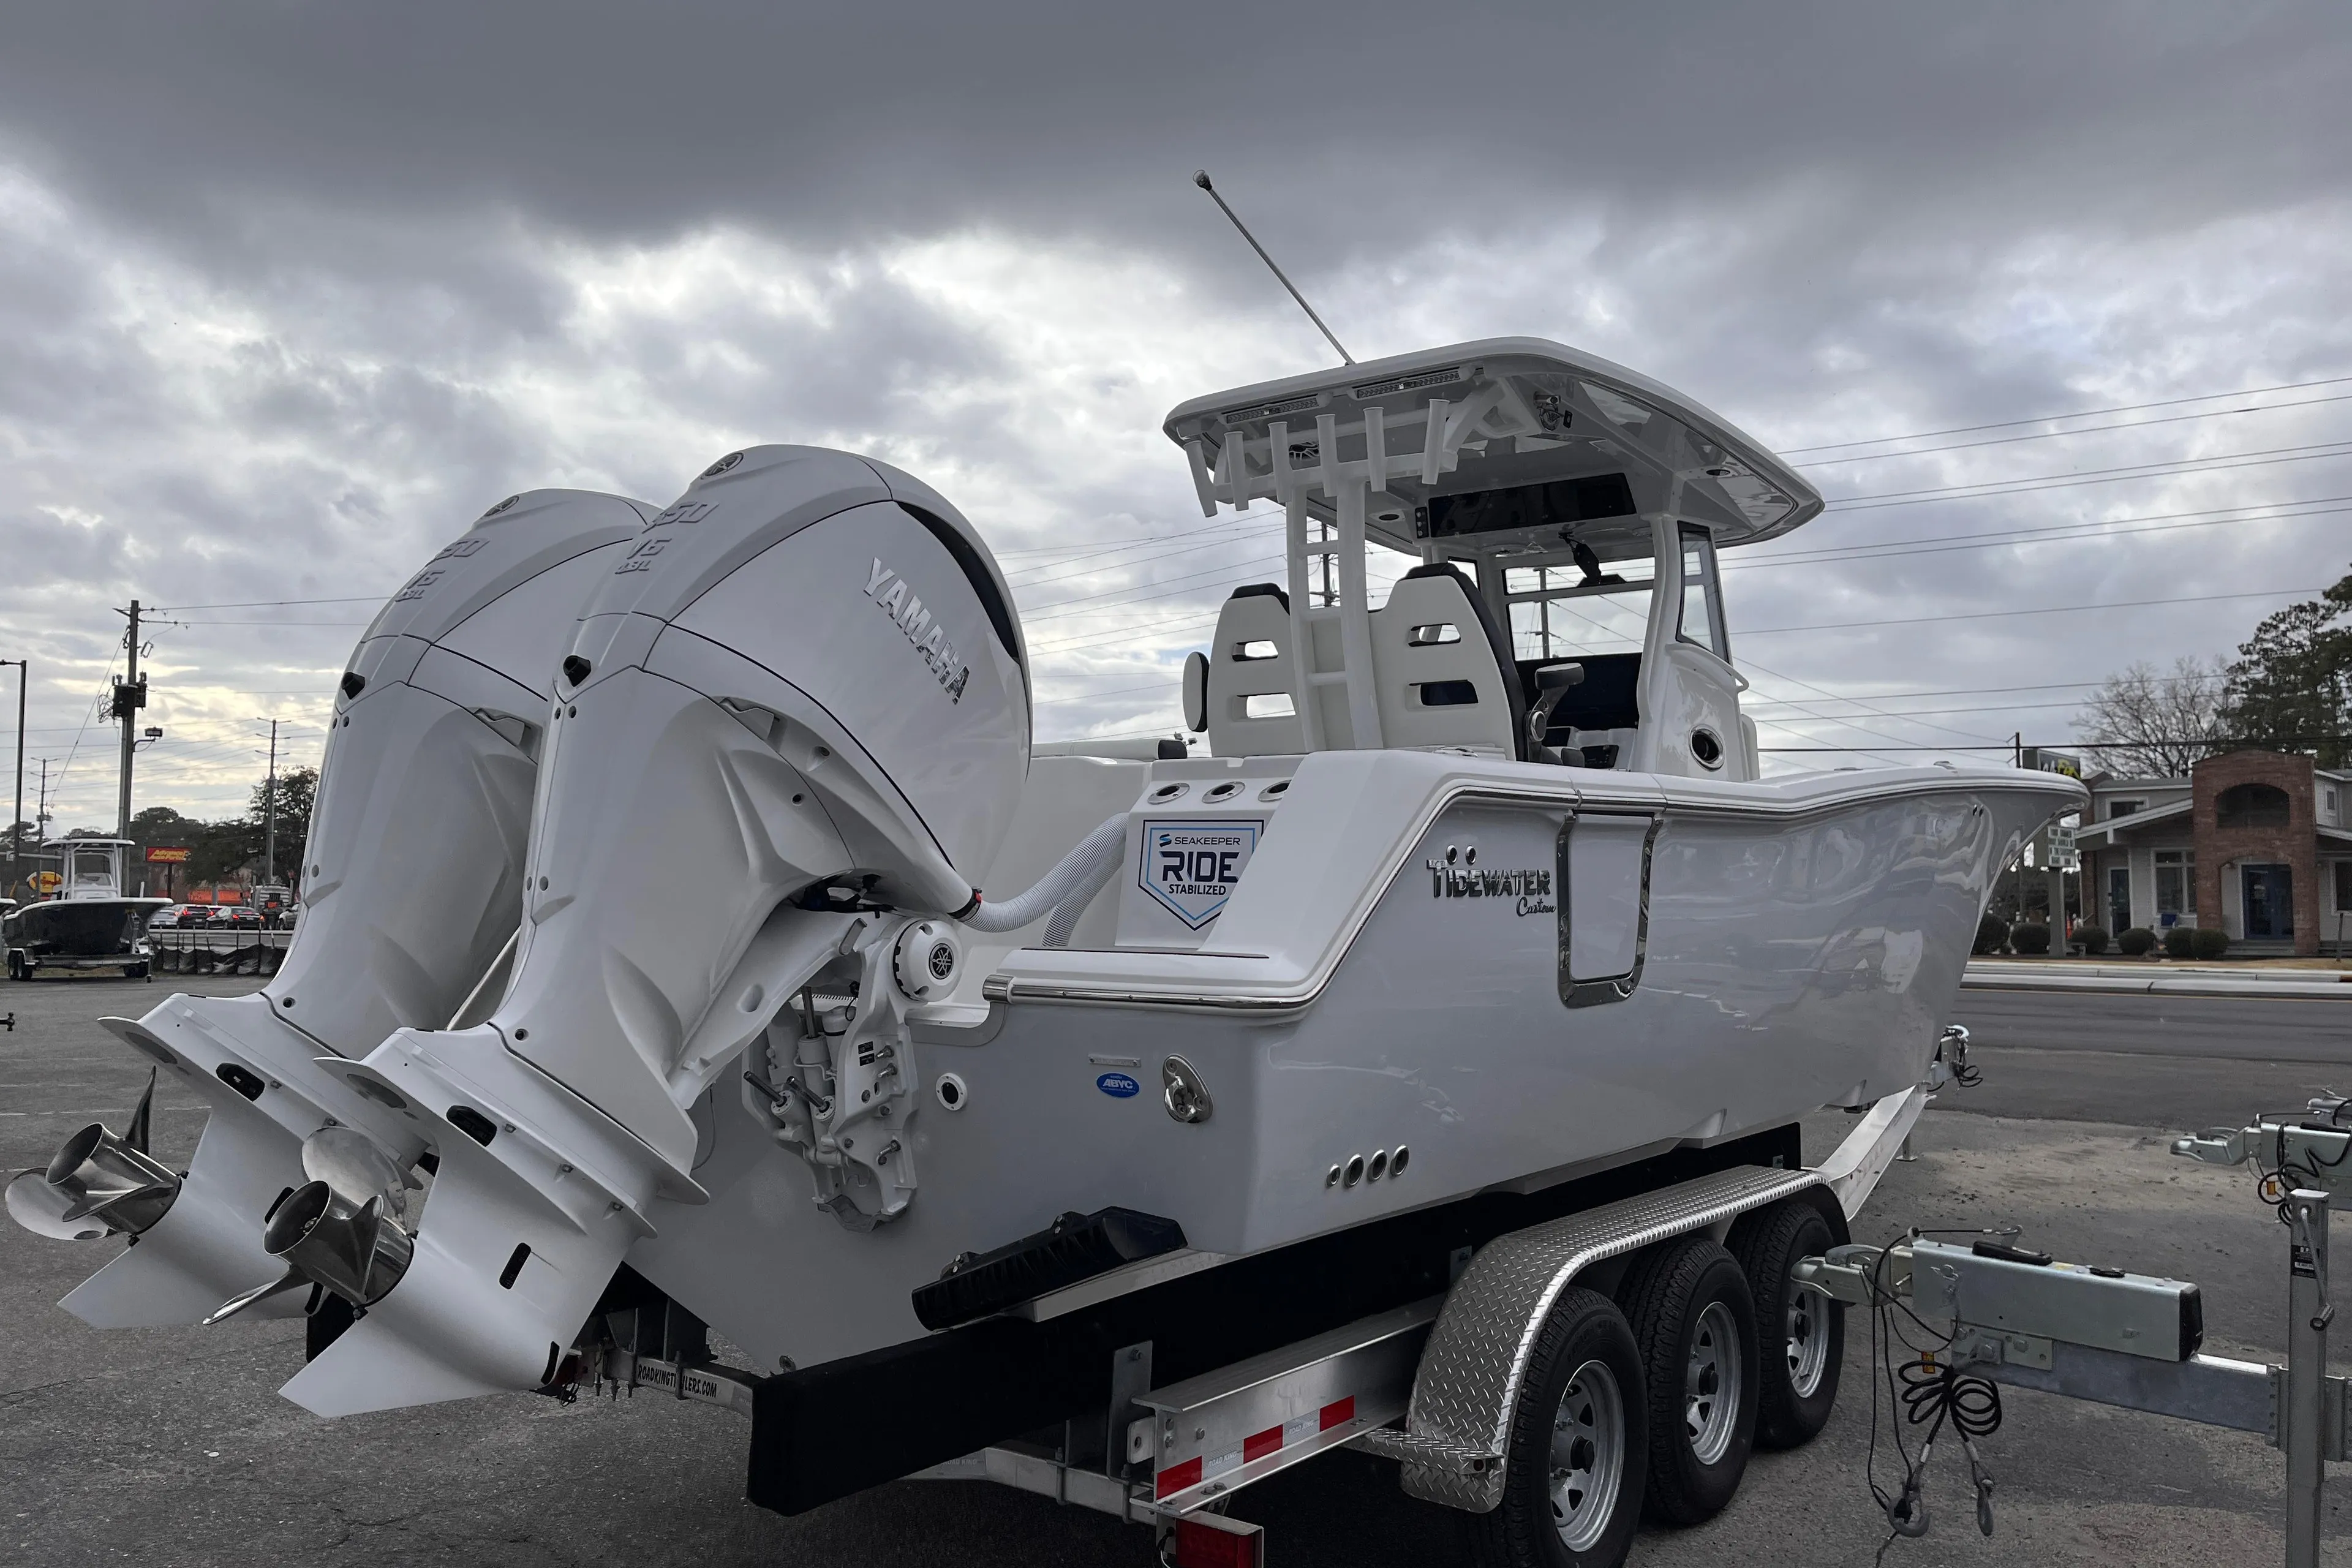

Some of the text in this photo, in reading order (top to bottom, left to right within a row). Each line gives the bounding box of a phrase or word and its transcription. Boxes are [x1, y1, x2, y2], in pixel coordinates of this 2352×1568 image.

[863, 556, 970, 705] YAMAHA
[1174, 837, 1240, 845] SEAKEEPER
[1159, 851, 1239, 883] RIDE
[1426, 859, 1551, 897] TIDEWATER
[1169, 884, 1226, 895] STABILIZED
[1516, 896, 1556, 916] Custom
[1102, 1079, 1133, 1089] ABYC
[1208, 1450, 1238, 1468] ROAD KING
